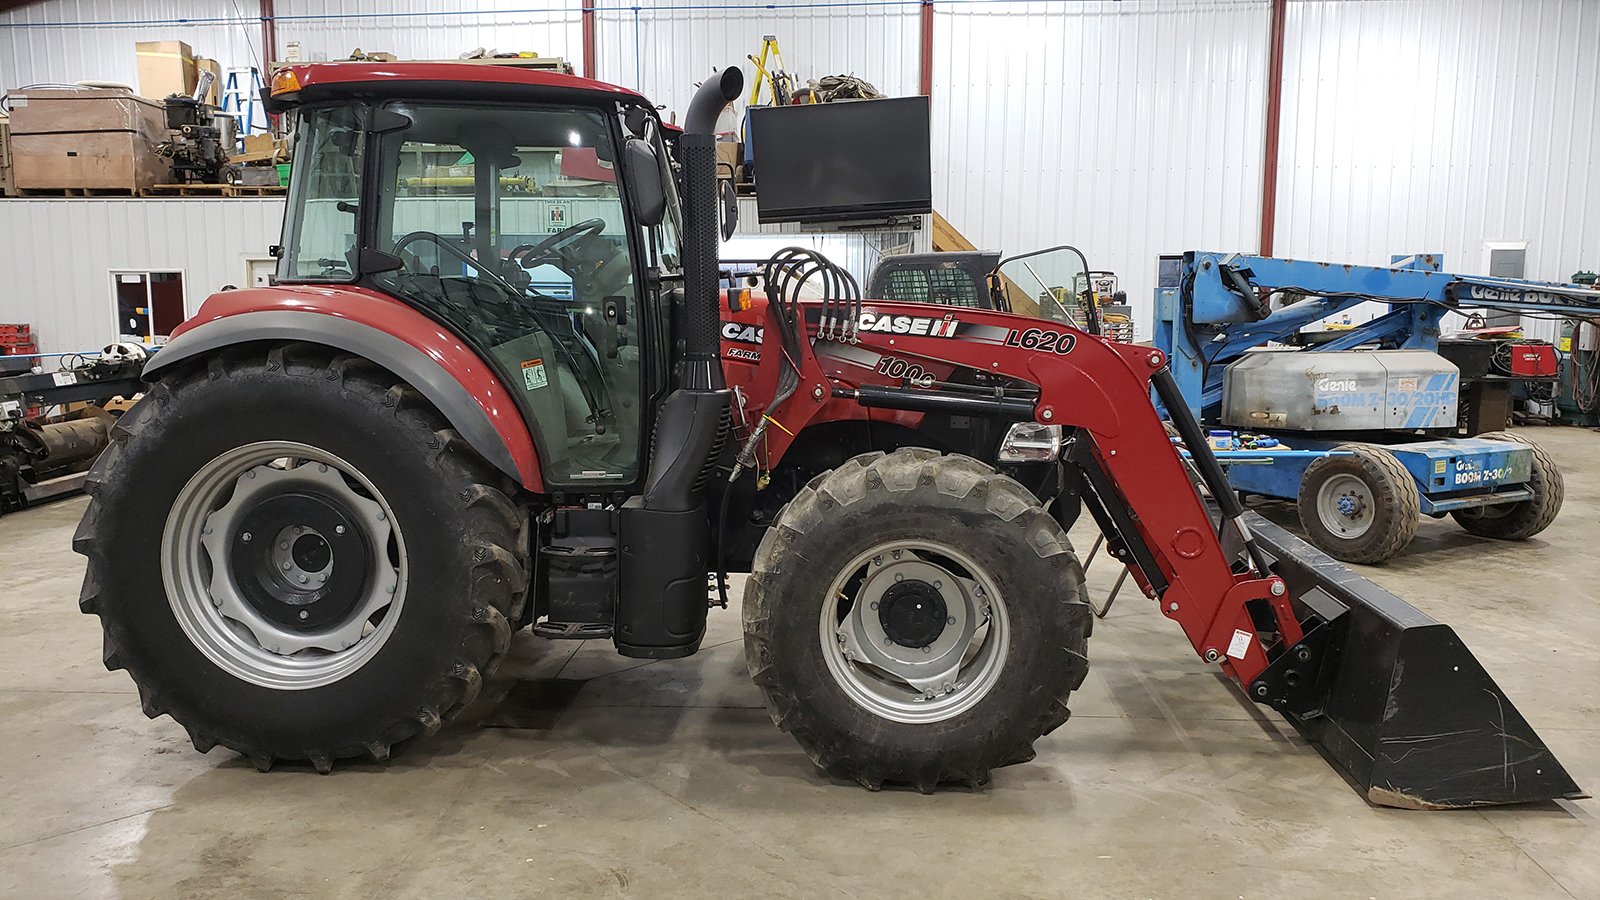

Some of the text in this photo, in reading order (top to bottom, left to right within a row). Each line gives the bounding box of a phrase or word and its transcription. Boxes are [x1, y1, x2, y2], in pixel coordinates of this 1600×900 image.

[858, 313, 931, 335] CASE
[1005, 327, 1077, 356] L620
[1318, 378, 1357, 392] Genie
